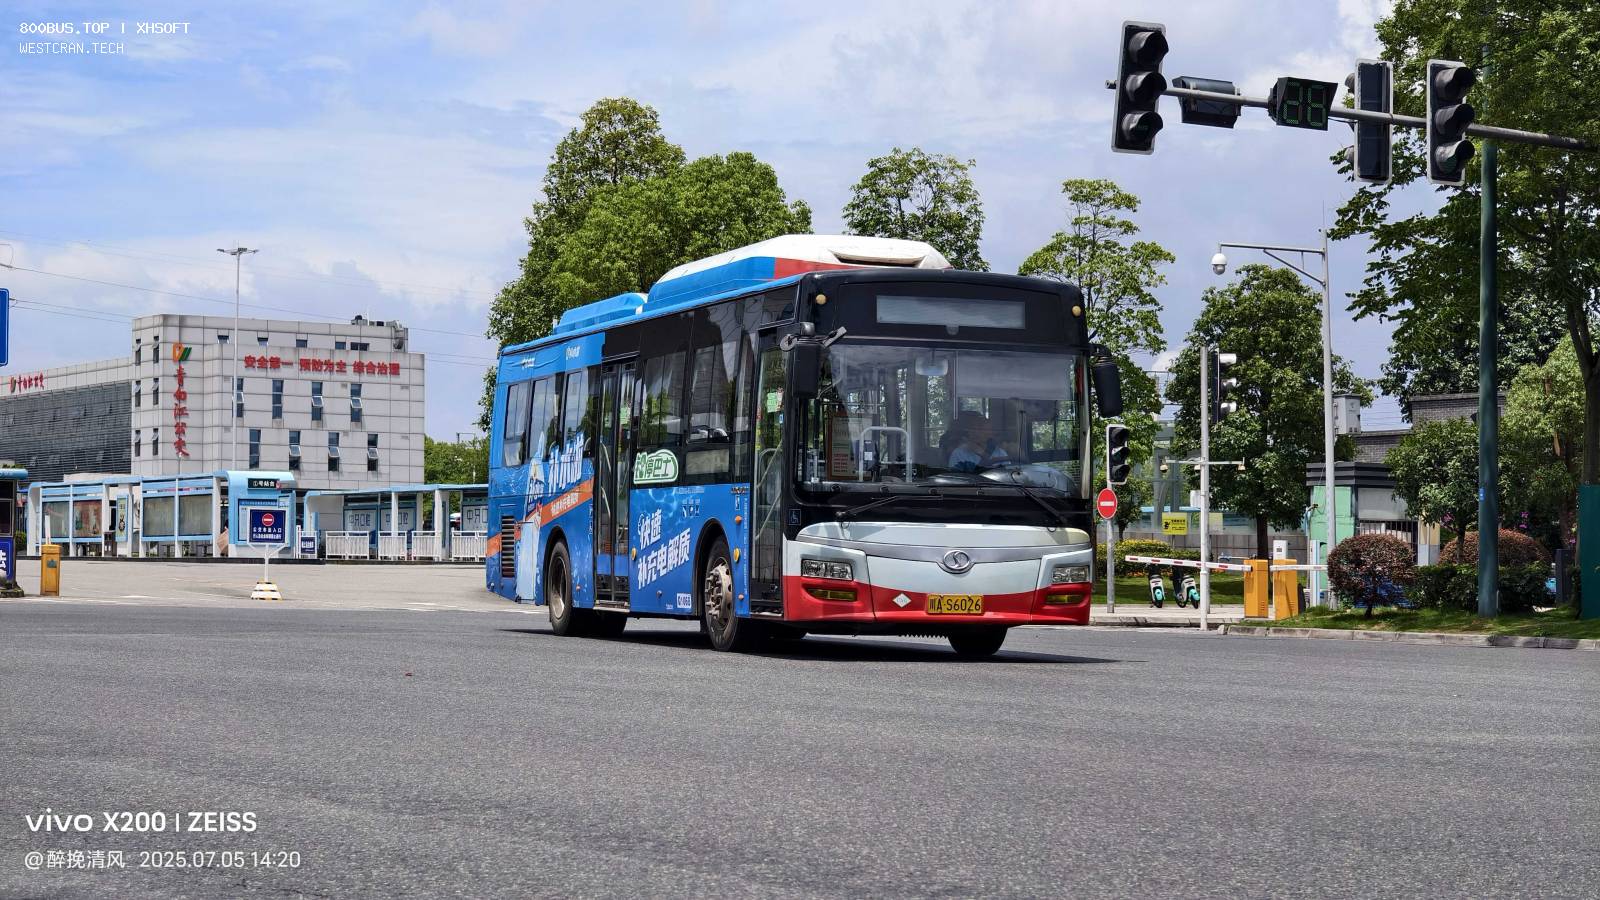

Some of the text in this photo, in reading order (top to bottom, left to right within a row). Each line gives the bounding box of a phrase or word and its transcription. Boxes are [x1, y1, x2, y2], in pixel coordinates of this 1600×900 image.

[244, 355, 400, 375] 安全第一 预防为主 综合治理
[639, 508, 662, 550] 快速
[637, 528, 691, 590] 补充电解质
